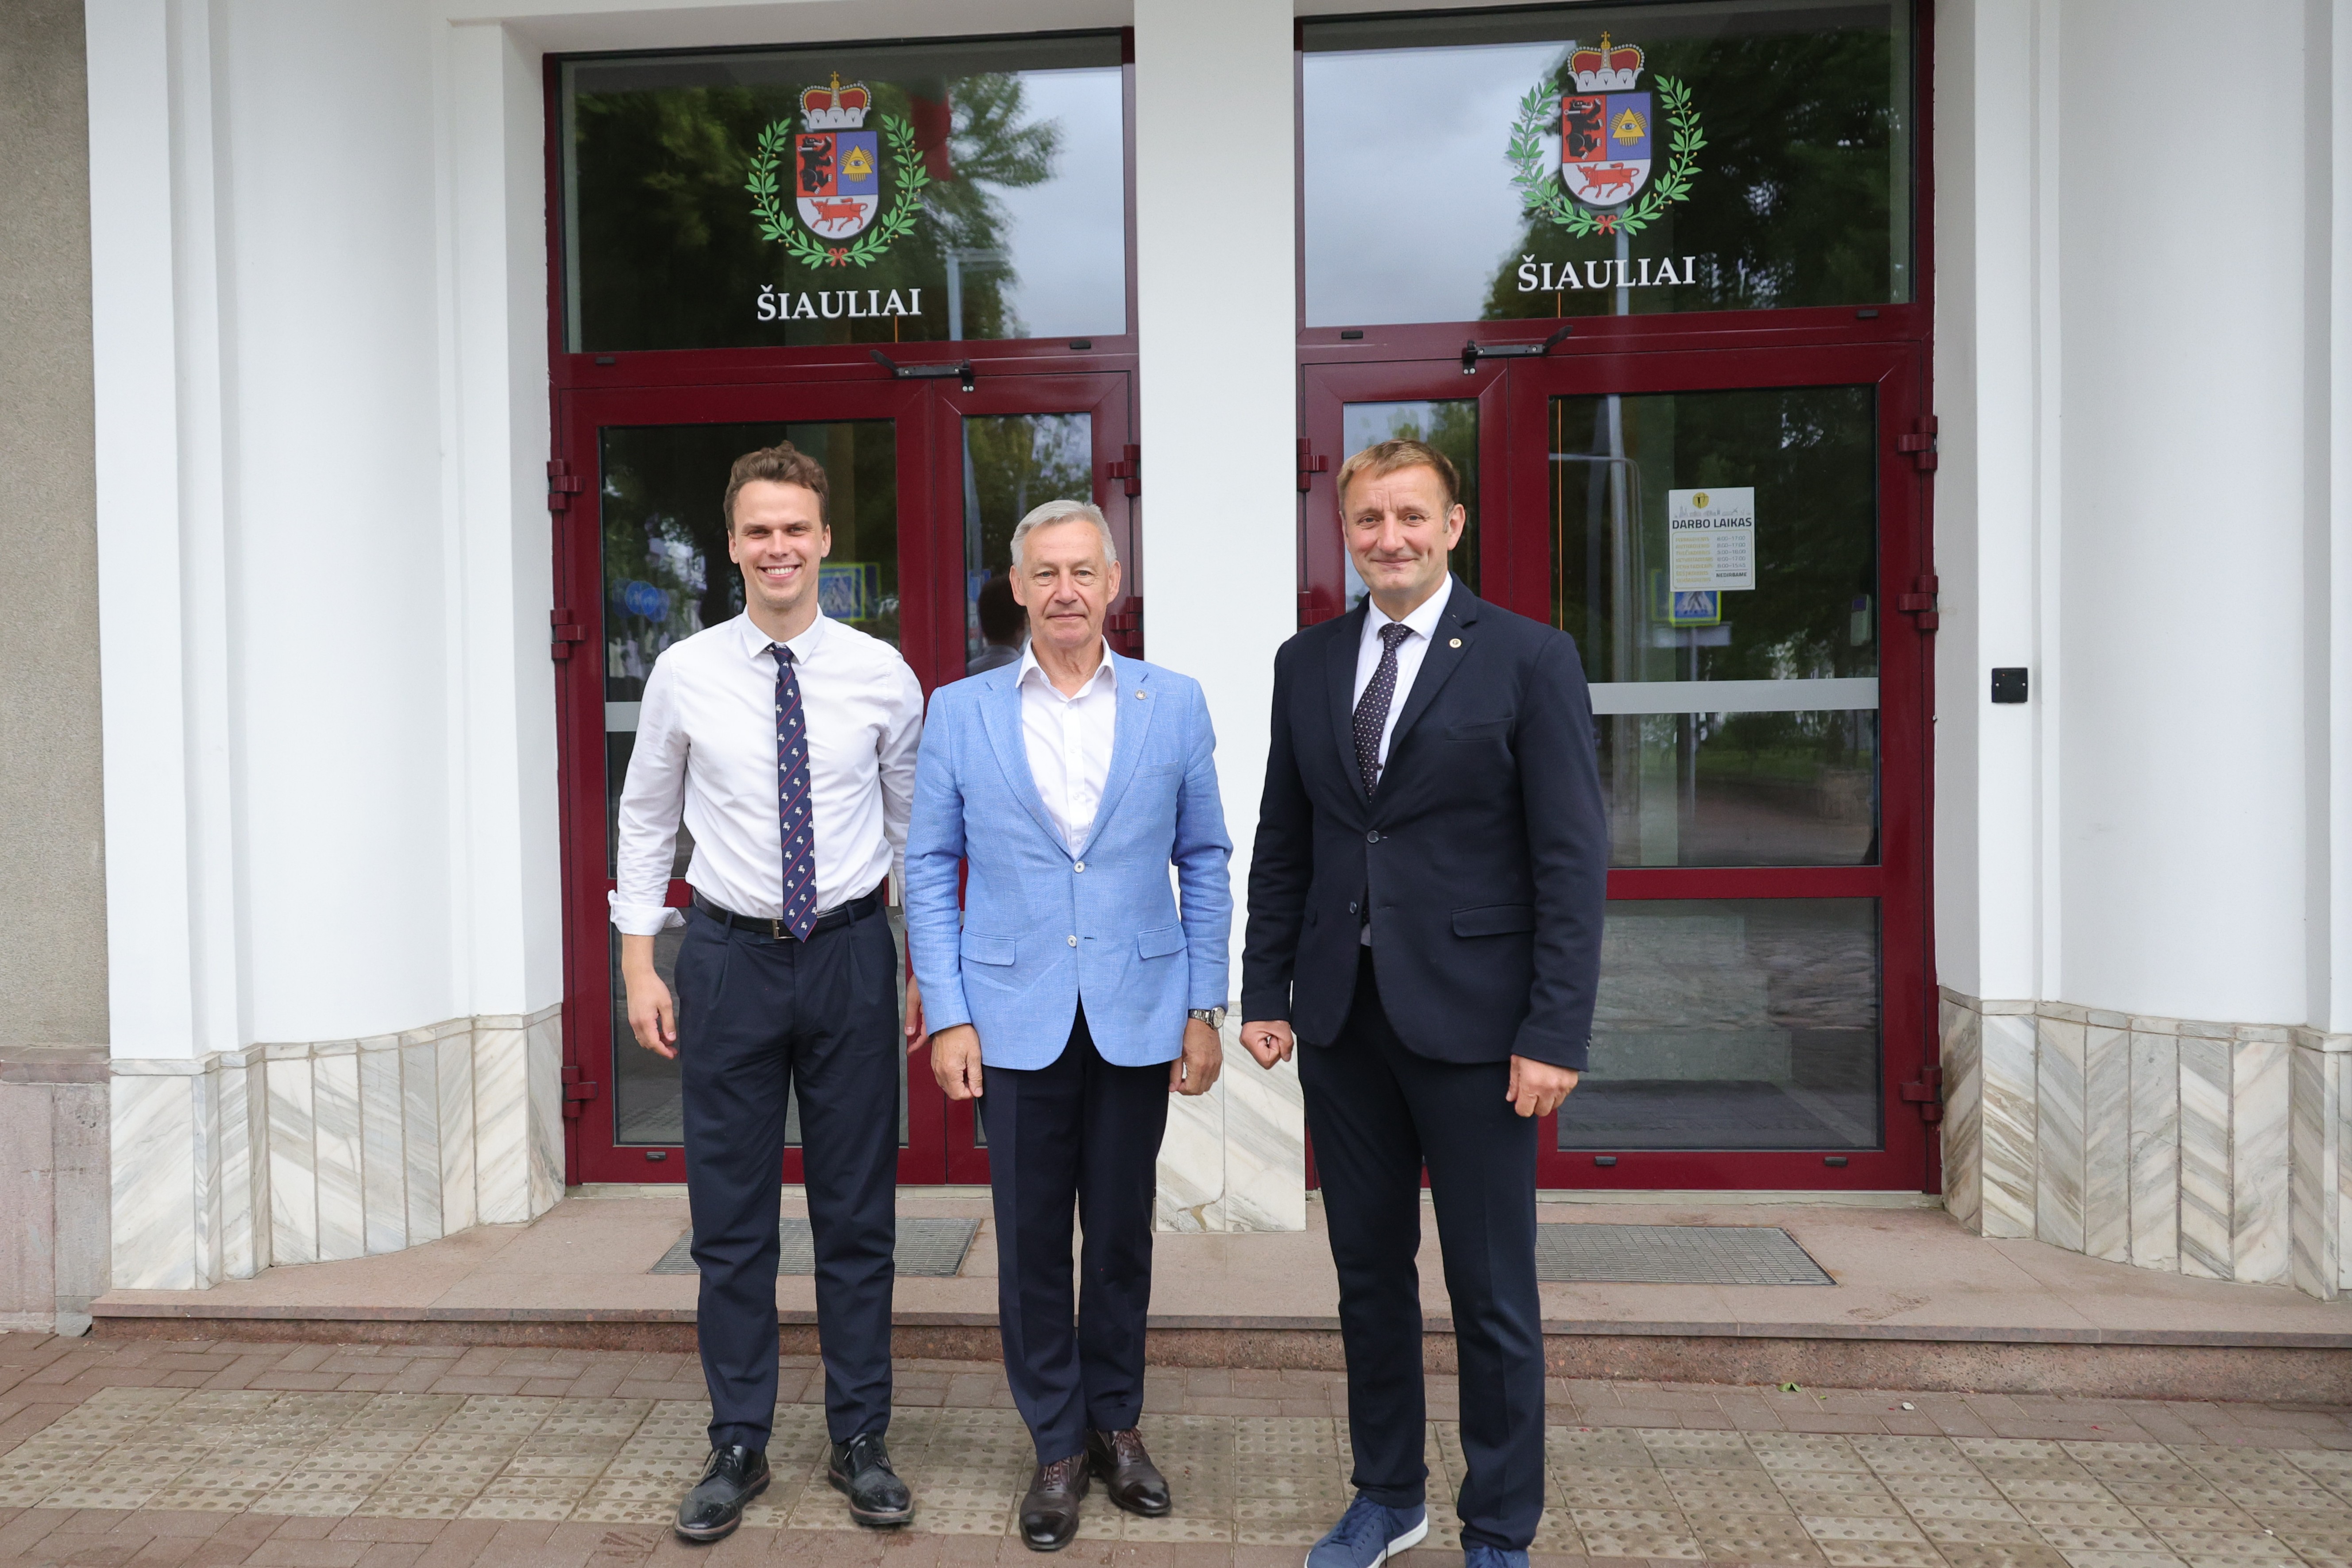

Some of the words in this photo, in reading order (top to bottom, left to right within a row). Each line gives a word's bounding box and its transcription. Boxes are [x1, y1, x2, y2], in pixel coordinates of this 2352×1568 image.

[1518, 254, 1696, 291] ŠIAULIAI
[757, 284, 922, 321] ŠIAULIAI
[1672, 519, 1711, 529] DARBO
[1714, 518, 1752, 528] LAIKAS
